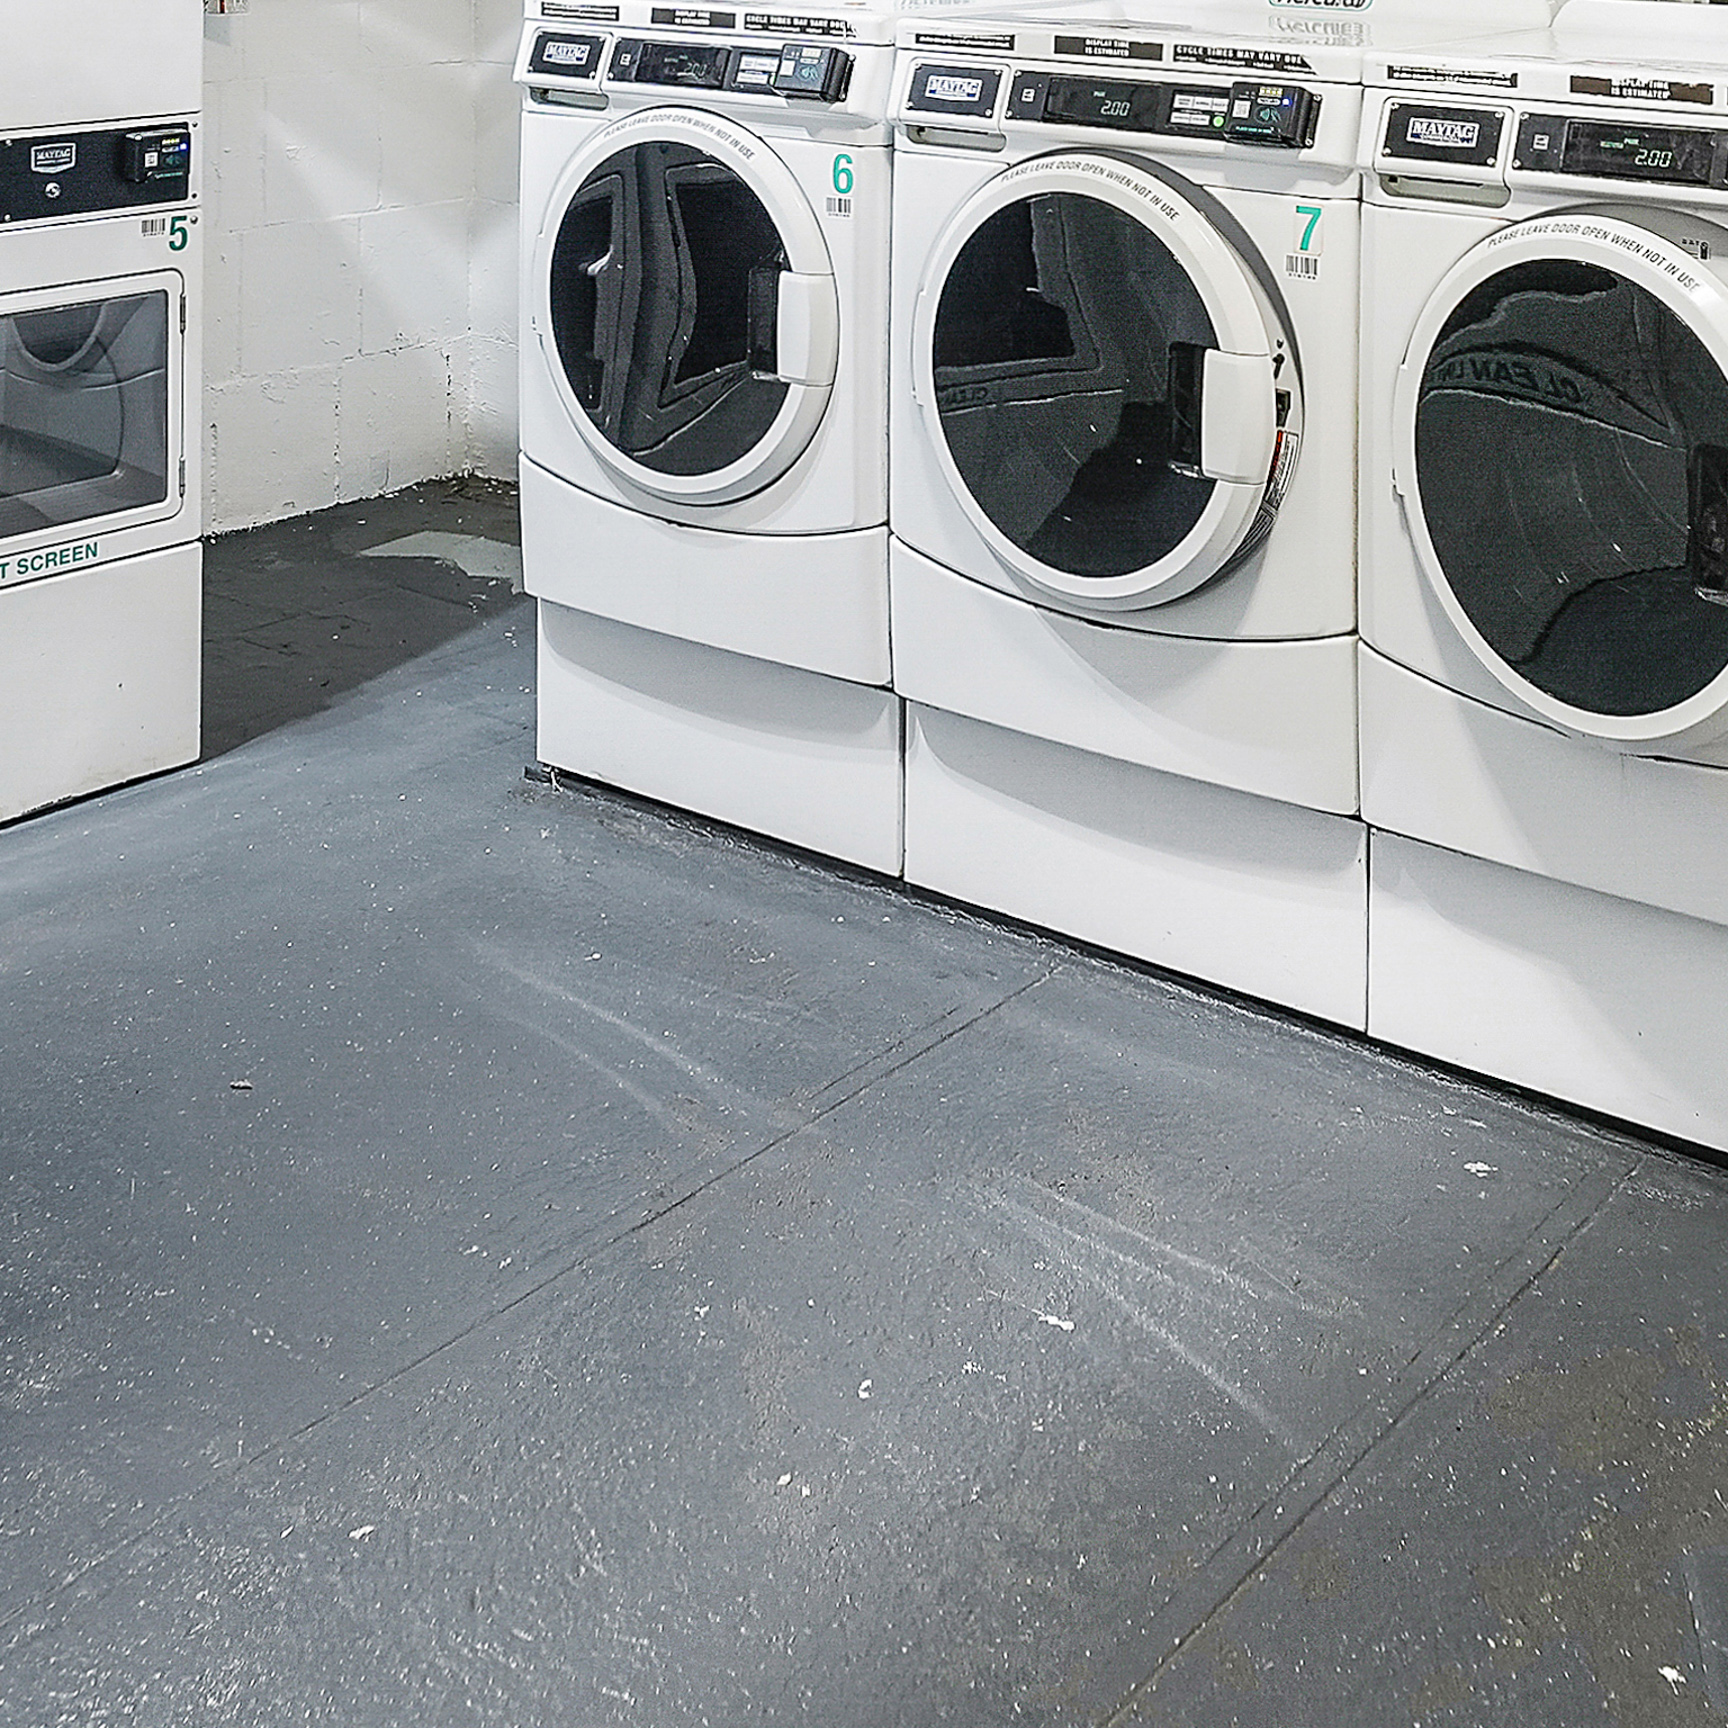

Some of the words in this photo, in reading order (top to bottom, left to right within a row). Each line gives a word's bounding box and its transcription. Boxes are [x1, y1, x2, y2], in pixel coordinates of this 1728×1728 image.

[1176, 46, 1204, 56] CYCLE
[1207, 47, 1234, 59] TIMES
[1237, 50, 1255, 60] MAY
[1258, 51, 1281, 63] VARY
[929, 78, 979, 94] MAYTAG
[628, 115, 651, 126] LEAVE
[651, 114, 673, 123] DOOR
[672, 114, 692, 125] OPEN
[692, 117, 714, 133] WHEN
[716, 126, 732, 142] NOT
[729, 137, 741, 149] IN
[738, 145, 756, 161] USE
[1412, 121, 1474, 139] MAYTAG
[833, 153, 854, 194] 6
[1634, 148, 1673, 168] 2.00
[1001, 166, 1030, 183] PLEASE
[1030, 160, 1056, 173] LEAVE
[1056, 159, 1082, 170] DOOR
[1082, 162, 1105, 176] OPEN
[1106, 168, 1132, 188] WHEN
[1131, 182, 1152, 199] NOT
[1149, 192, 1163, 207] IN
[1161, 202, 1181, 222] USE
[169, 215, 188, 251] 5
[1296, 205, 1322, 251] 7
[1488, 228, 1520, 249] PLEASE
[1521, 223, 1550, 236] LEAVE
[1551, 223, 1580, 234] DOOR
[1581, 225, 1610, 241] OPEN
[1610, 232, 1642, 255] WHEN
[1642, 248, 1667, 267] NOT
[1663, 262, 1681, 276] IN
[1677, 272, 1702, 293] USE
[16, 541, 98, 576] SCREEN
